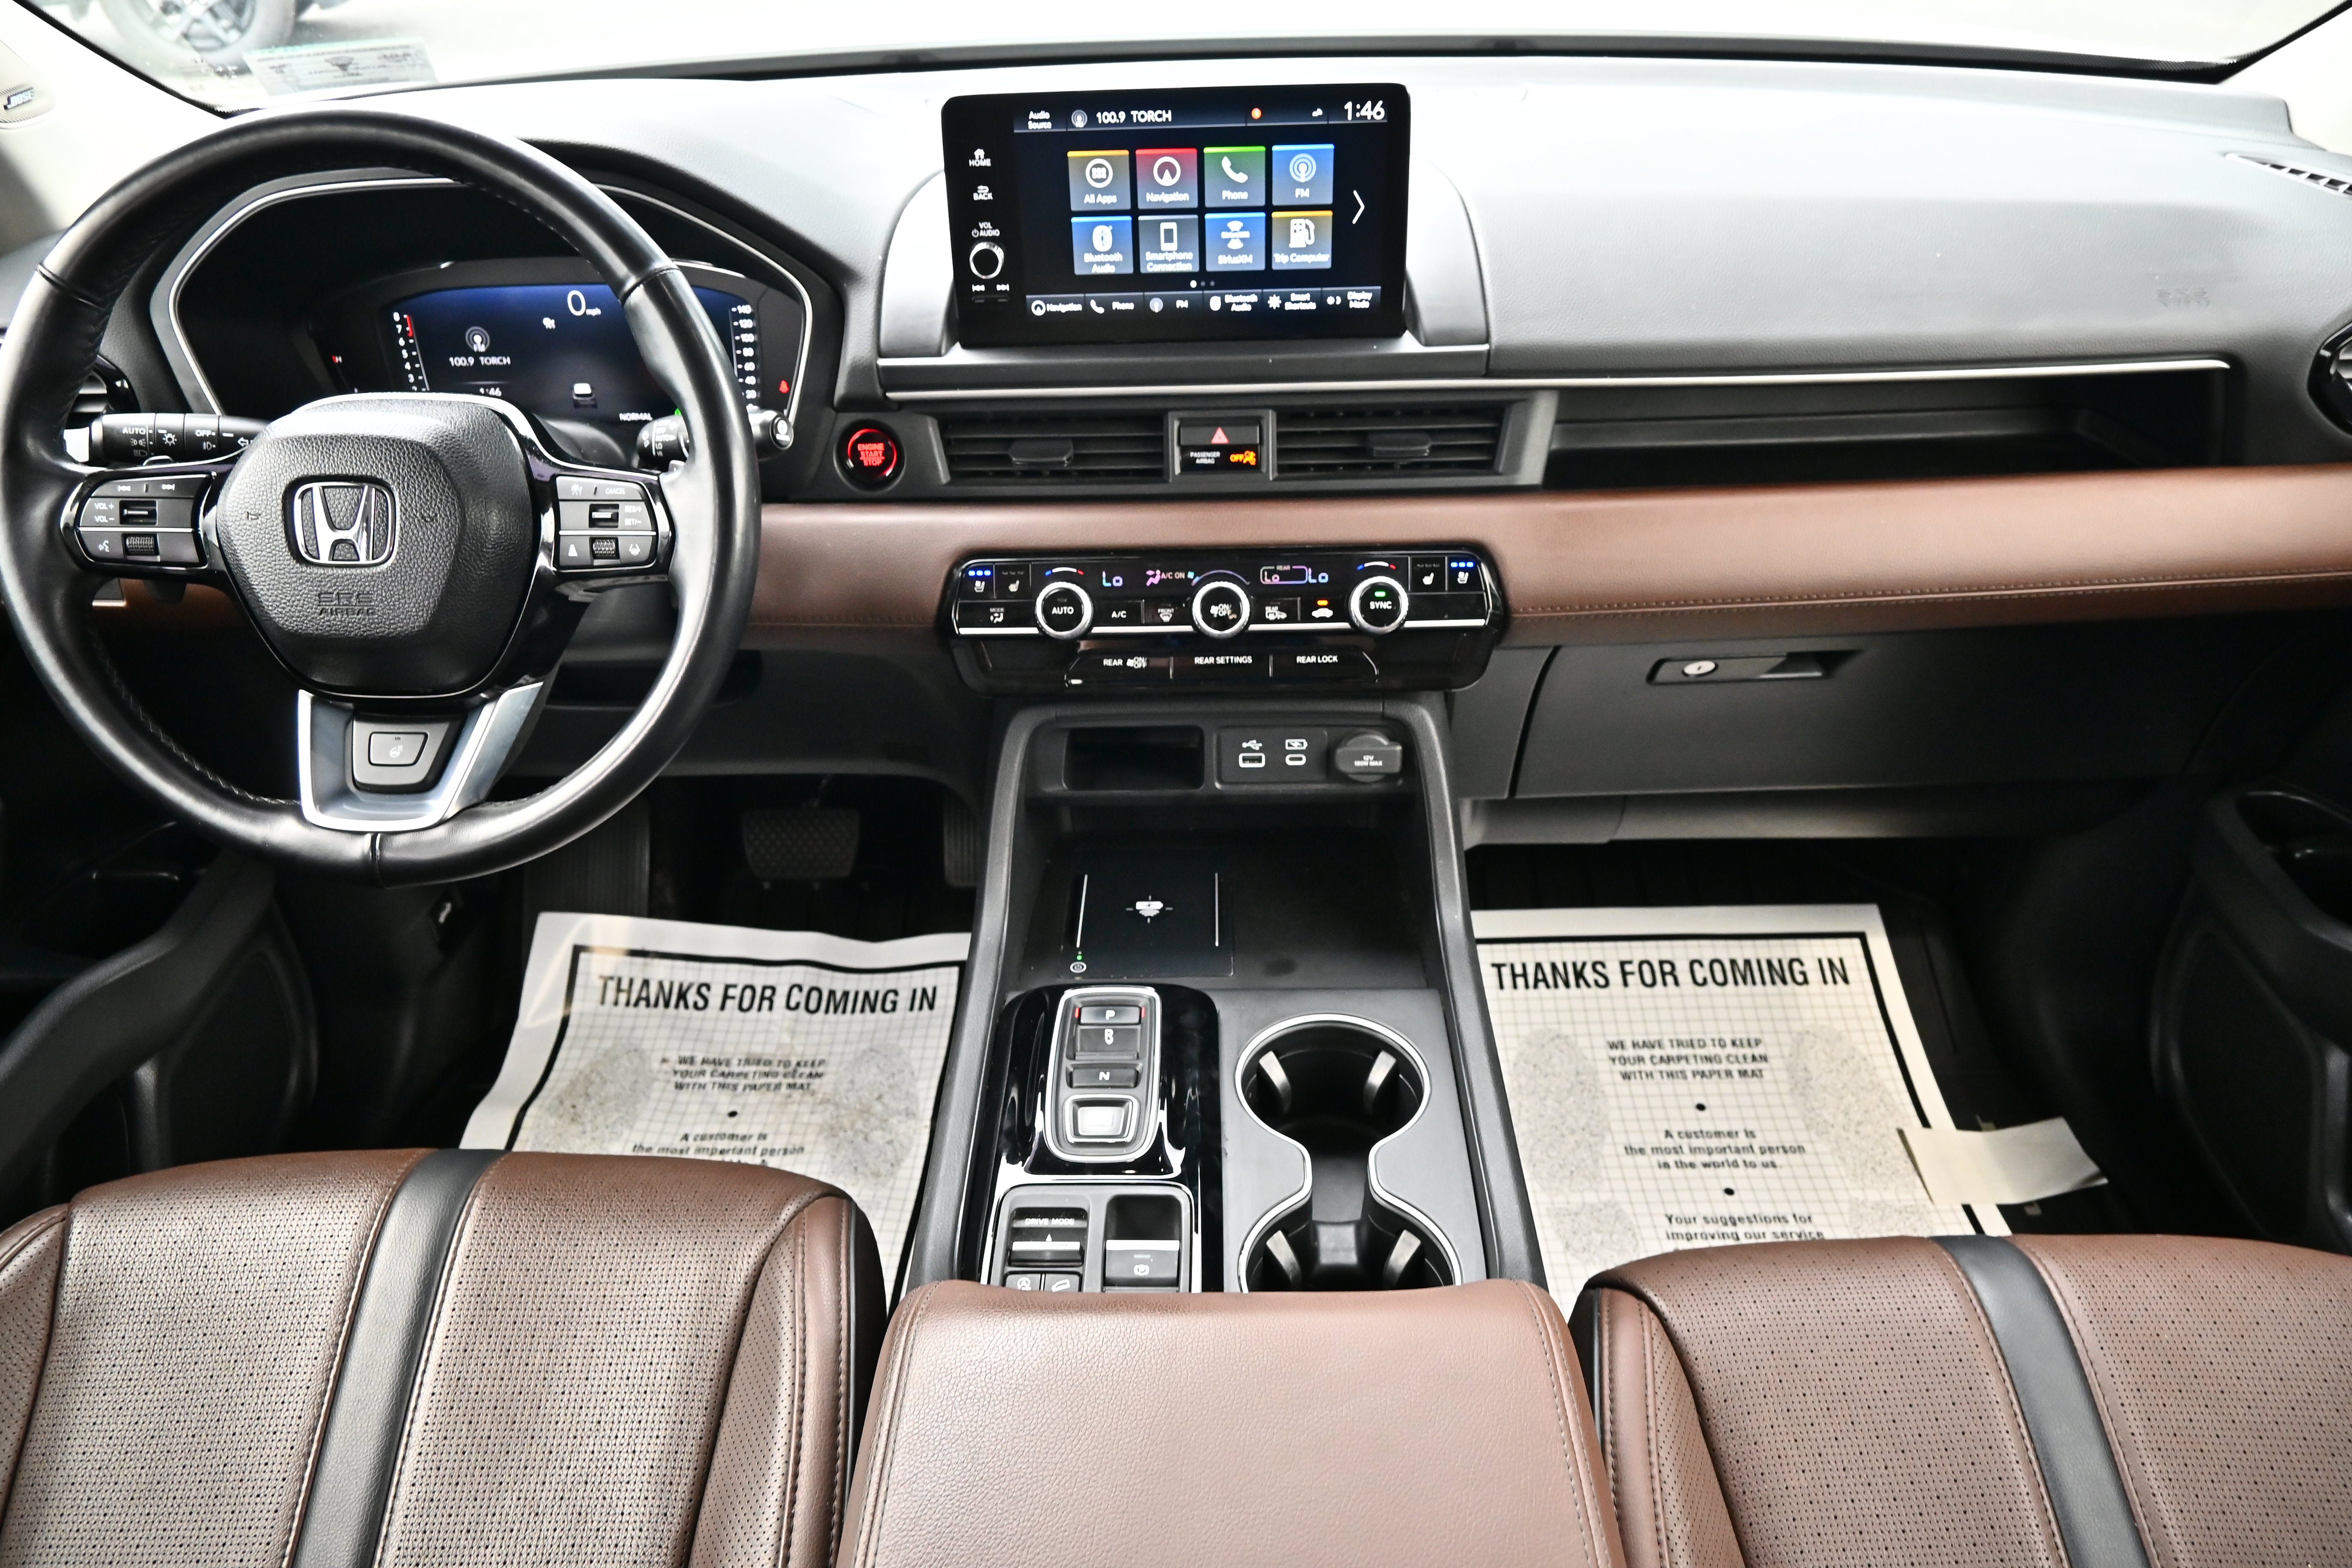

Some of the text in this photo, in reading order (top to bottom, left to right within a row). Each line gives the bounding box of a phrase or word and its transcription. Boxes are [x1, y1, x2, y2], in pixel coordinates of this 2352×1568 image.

[1029, 110, 1050, 119] Audio
[1344, 100, 1385, 120] 1:46
[1097, 110, 1172, 123] 100.9 TORCH
[1028, 120, 1051, 129] Source
[969, 158, 991, 166] HOME
[973, 192, 993, 200] BACK
[1146, 191, 1190, 203] Navigation
[1222, 190, 1248, 200] Phone
[1295, 188, 1309, 198] FM
[1084, 193, 1117, 204] All Apps
[1083, 252, 1123, 263] Bluetooth
[1146, 251, 1193, 261] Smartphone
[1218, 254, 1252, 264] SiriusXM
[1273, 253, 1330, 264] Trip Computer
[1092, 263, 1115, 273] Audio
[1146, 261, 1192, 272] Connection
[567, 290, 602, 316] 0 mph
[1047, 302, 1082, 313] Navigation
[1112, 301, 1134, 310] Phone
[1176, 299, 1188, 308] FM
[737, 305, 751, 314] 140
[393, 312, 400, 322] 8
[396, 324, 402, 334] 7
[739, 319, 753, 329] 120
[399, 337, 405, 346] 6
[740, 333, 754, 343] 100
[474, 343, 486, 353] FM
[743, 347, 754, 357] 80
[402, 349, 408, 359] 5
[405, 362, 411, 371] 4
[449, 356, 511, 367] 100.9 TORCH
[744, 362, 755, 371] 60
[408, 373, 414, 383] 3
[745, 376, 756, 385] 40
[479, 387, 502, 397] 1:46
[746, 389, 757, 399] 20
[619, 412, 653, 421] NORMAL
[1230, 454, 1244, 462] OFF
[318, 592, 373, 605] SRS
[1052, 606, 1074, 615] AUTO
[1370, 601, 1392, 610] SYNC
[1216, 656, 1252, 664] SETTINGS
[1297, 655, 1338, 664] REAR LOCK
[1491, 957, 1851, 990] THANKS FOR COMING IN
[597, 975, 937, 1015] THANKS FOR COMING IN
[1106, 1010, 1115, 1020] P
[1607, 1037, 1763, 1050] WE HAVE TRIED TO KEEP
[678, 1055, 826, 1069] WE HAVE TRIED TO KEEP
[1609, 1054, 1769, 1066] YOUR CARPETING CLEAN
[672, 1069, 824, 1080] YOUR CARPETING CLEAN
[1099, 1072, 1110, 1081] N
[1620, 1070, 1654, 1081] WITH
[1658, 1070, 1688, 1080] THIS
[1691, 1069, 1734, 1080] PAPER
[675, 1082, 706, 1091] WITH
[711, 1081, 739, 1092] THIS
[742, 1082, 782, 1092] PAPER
[680, 1133, 768, 1141] A customer is
[1664, 1129, 1756, 1140] A customer is
[632, 1144, 805, 1157] the most important person
[1625, 1145, 1806, 1156] the most important person
[1675, 1160, 1696, 1169] the
[1702, 1159, 1739, 1169] world
[1743, 1159, 1757, 1169] to
[1761, 1160, 1783, 1169] us.
[1665, 1214, 1813, 1226] Your suggestions for
[1666, 1230, 1825, 1241] improving our service
